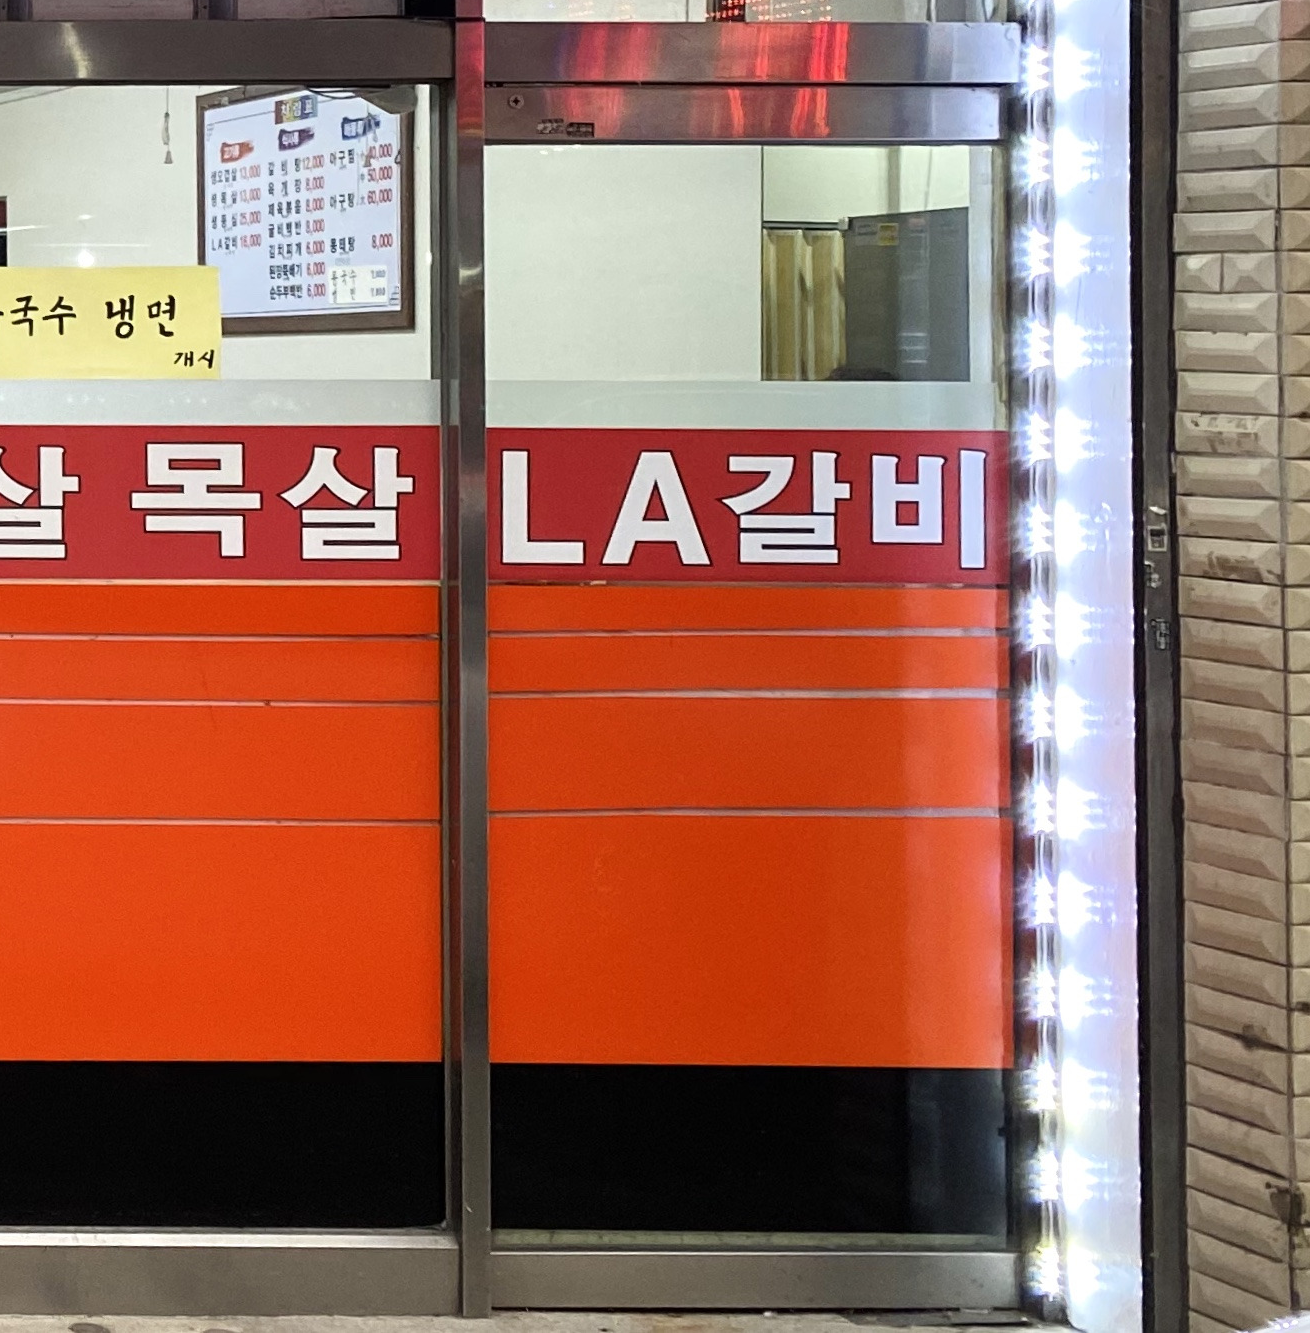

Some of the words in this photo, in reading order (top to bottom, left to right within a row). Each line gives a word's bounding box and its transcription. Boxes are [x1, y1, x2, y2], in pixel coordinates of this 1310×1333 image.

[367, 165, 393, 185] 50,000
[105, 294, 178, 339] 냉면
[173, 348, 216, 371] 개시
[128, 440, 415, 562] 목살
[500, 449, 988, 570] LA갈비
